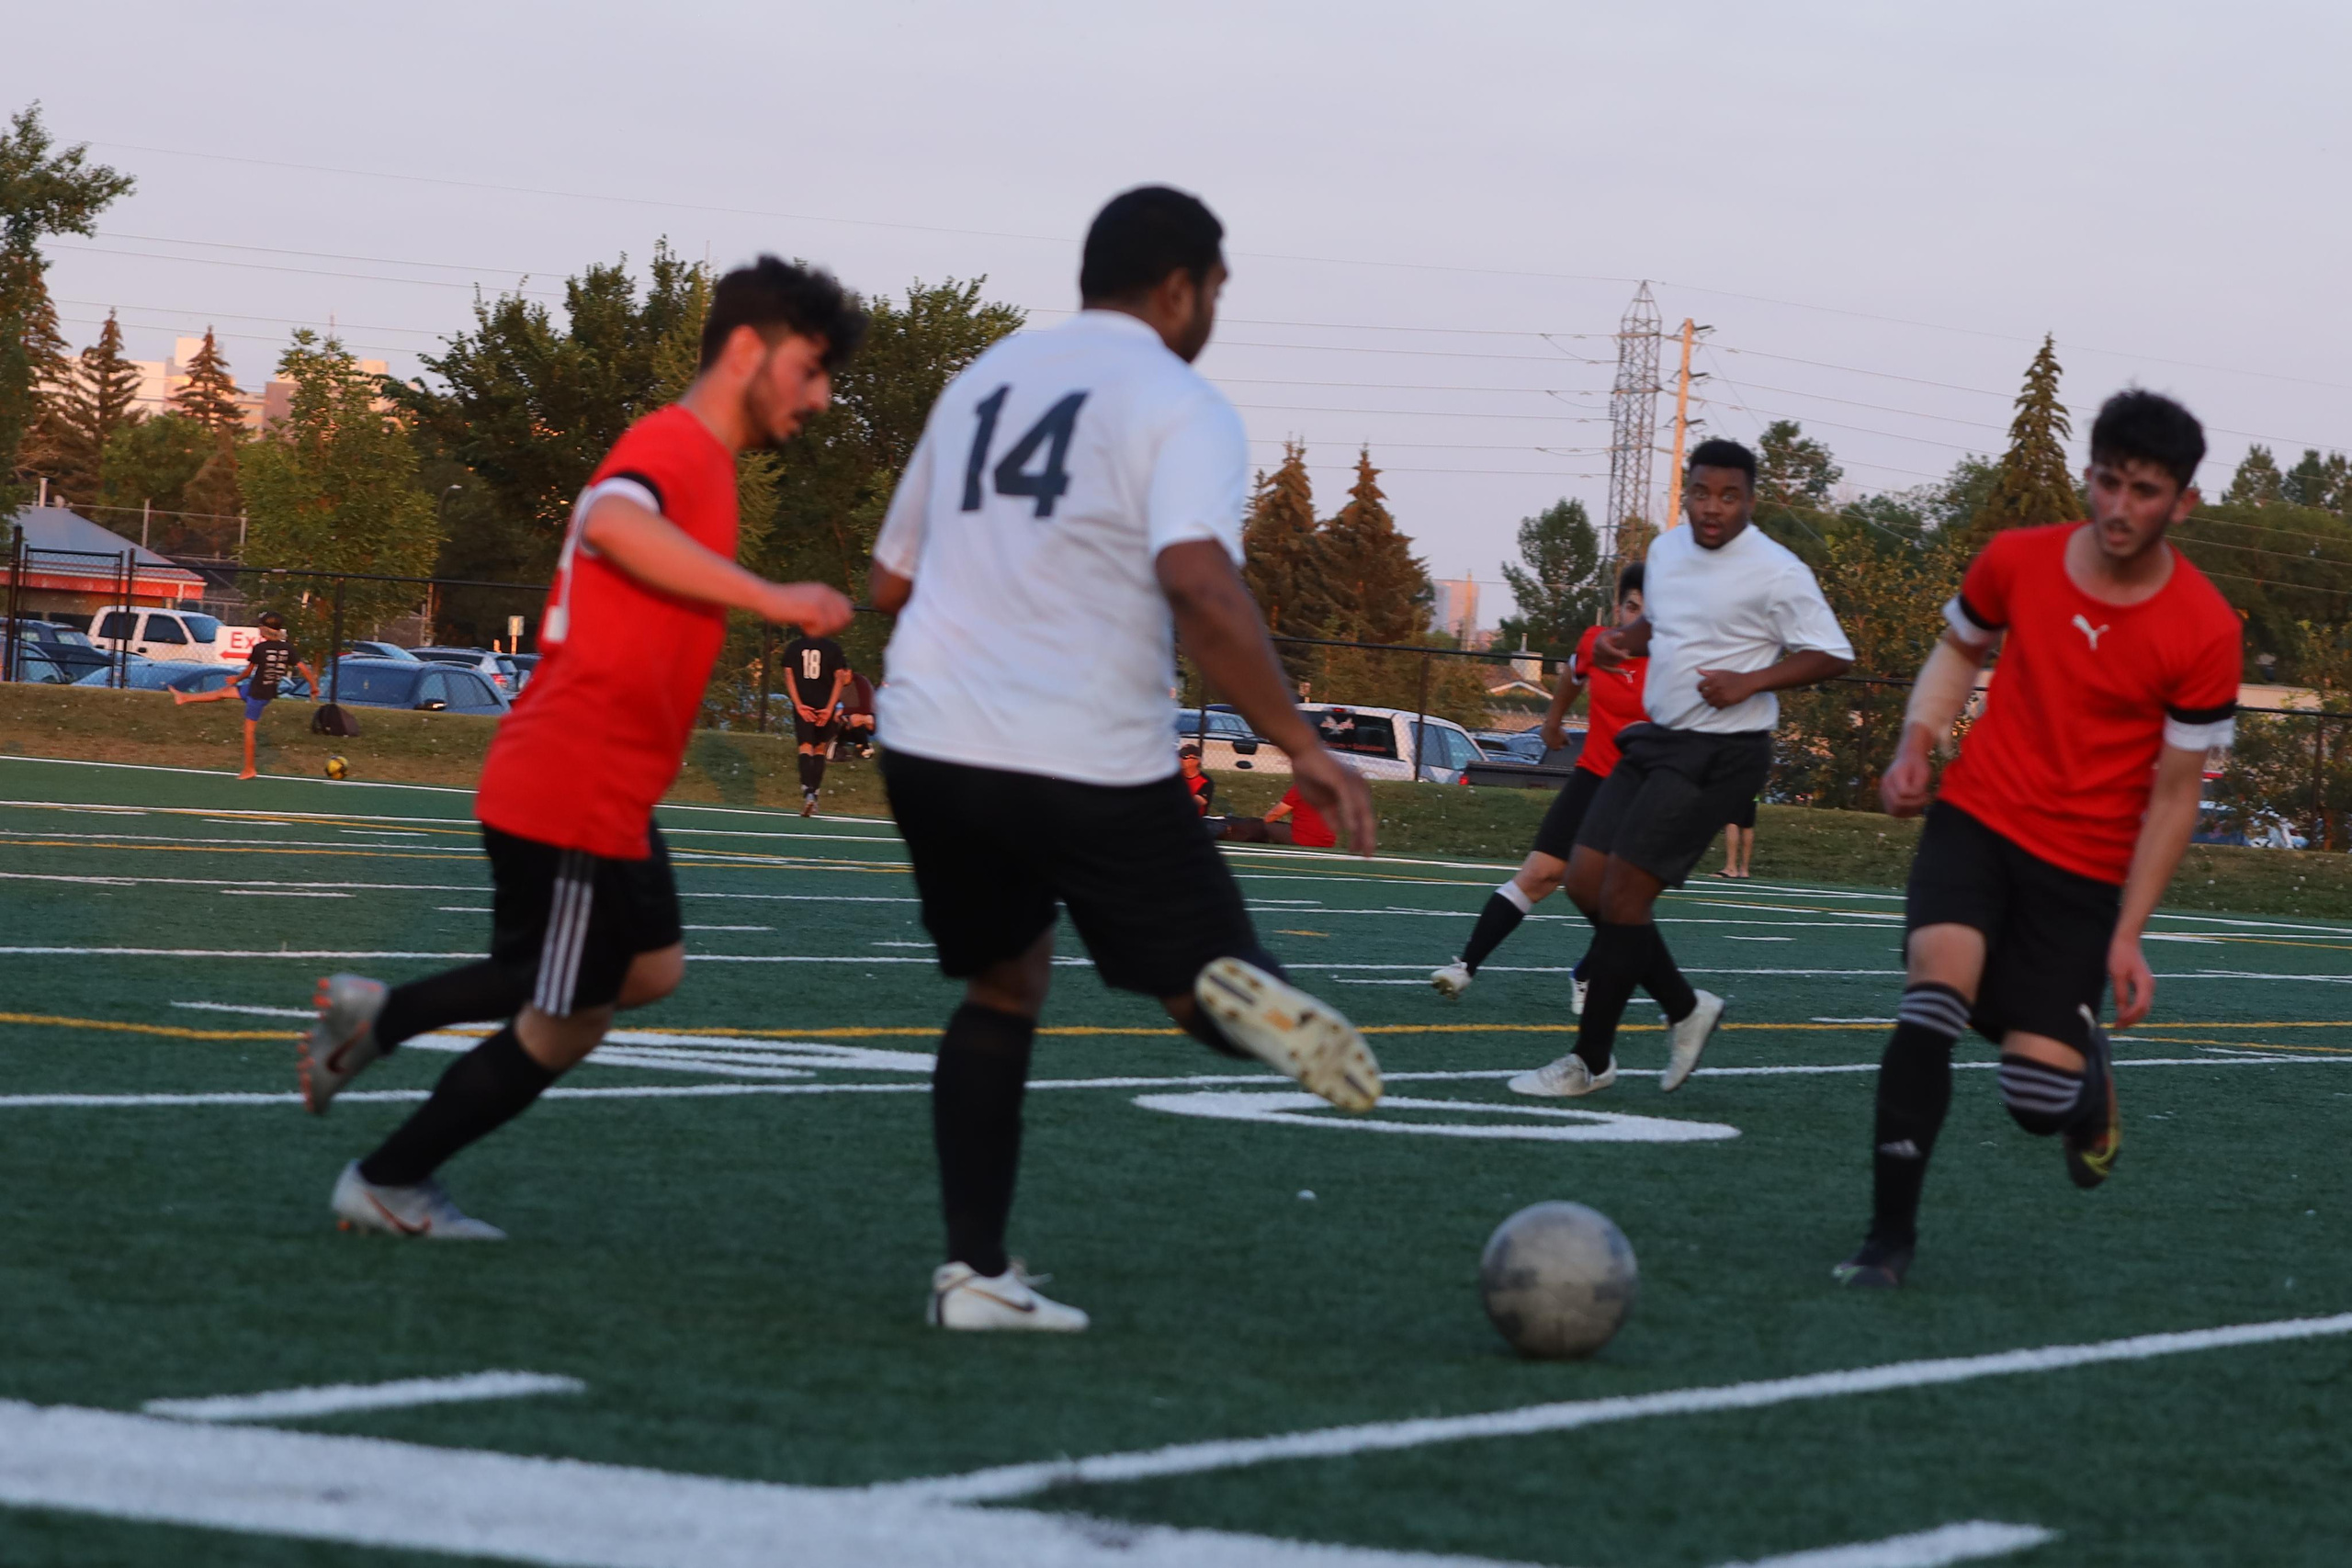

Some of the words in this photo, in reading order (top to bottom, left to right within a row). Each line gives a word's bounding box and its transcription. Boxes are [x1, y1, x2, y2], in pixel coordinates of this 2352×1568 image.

[960, 381, 1092, 517] 14
[231, 631, 267, 649] Ex
[801, 649, 821, 680] 18
